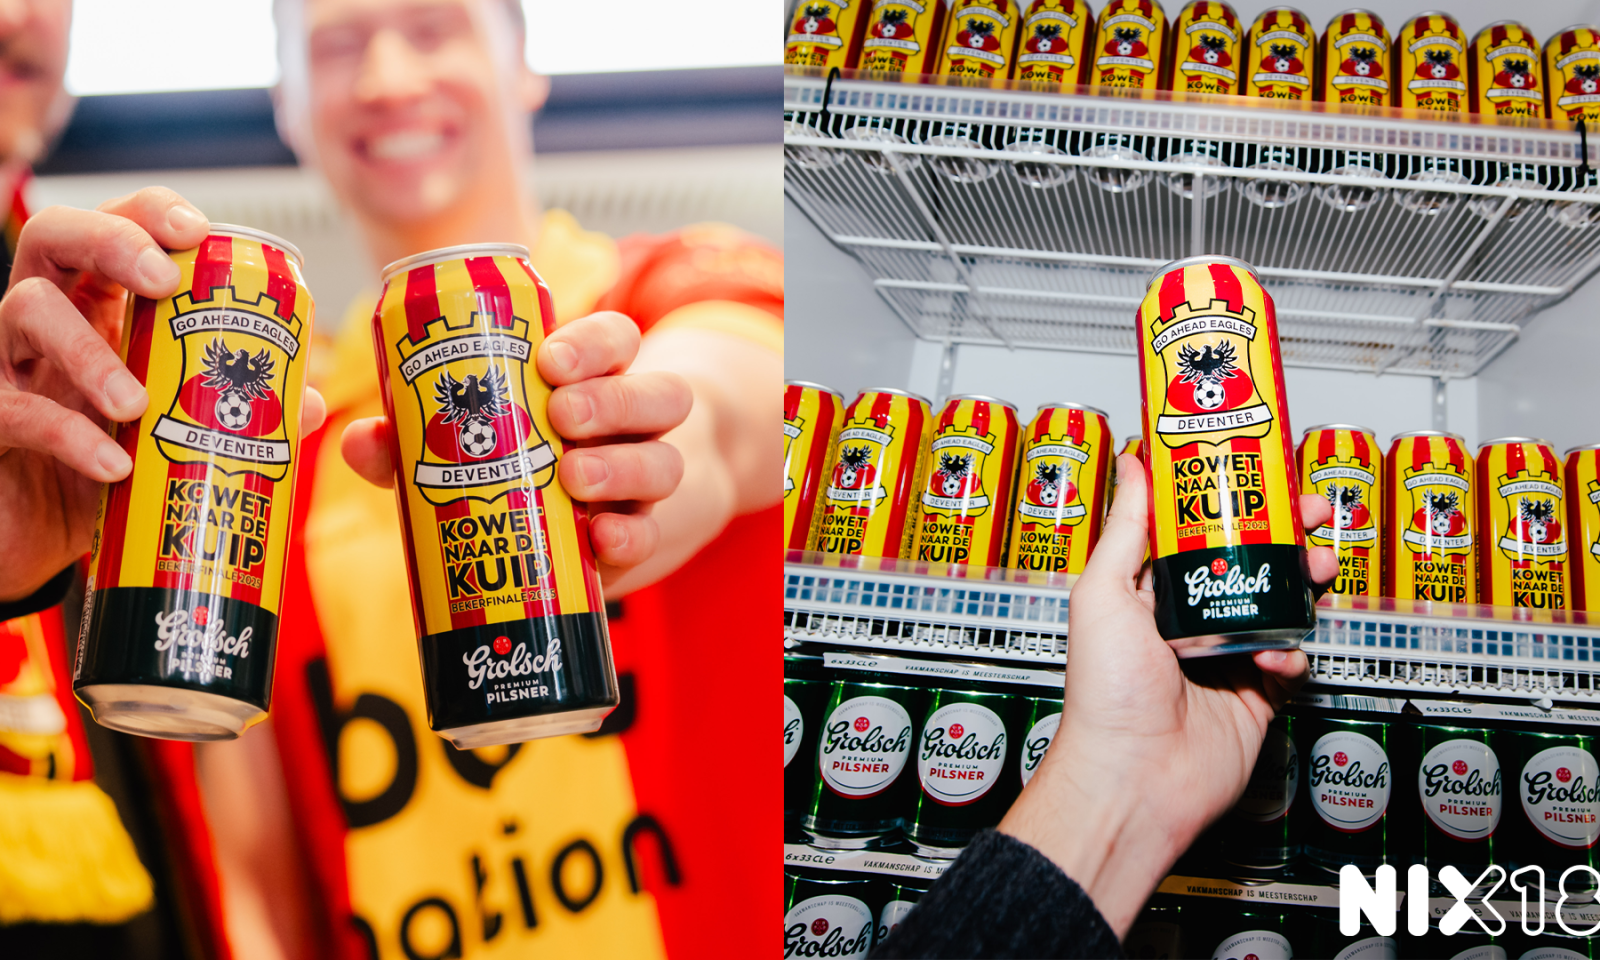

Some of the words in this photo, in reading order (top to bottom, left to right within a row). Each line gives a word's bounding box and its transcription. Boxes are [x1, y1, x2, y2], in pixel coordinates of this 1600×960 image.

[949, 64, 994, 78] KOWET
[1021, 70, 1063, 82] KOWET
[1100, 74, 1144, 85] KOWET
[1187, 81, 1229, 95] KOWET
[1417, 97, 1460, 109] KOWET
[176, 317, 197, 332] GO
[201, 315, 250, 328] AHEAD
[253, 320, 295, 353] EAGLES
[1155, 335, 1168, 349] GO
[1170, 320, 1207, 338] AHEAD
[1210, 319, 1252, 336] EAGLES
[405, 359, 422, 377] GO
[424, 342, 469, 365] AHEAD
[473, 340, 526, 356] EAGLES
[1177, 411, 1254, 430] DEVENTER
[186, 429, 275, 459] DEVENTER
[940, 438, 962, 446] AHEAD
[962, 439, 990, 452] EAGLES
[1036, 447, 1058, 455] AHEAD
[1058, 448, 1086, 460] EAGLES
[442, 456, 534, 483] DEVENTER
[1173, 453, 1261, 480] KOWET
[1312, 472, 1322, 481] GO
[1323, 469, 1347, 478] AHEAD
[1348, 469, 1373, 482] EAGLES
[1175, 474, 1230, 496] NAAR
[1236, 472, 1263, 488] DE
[1407, 478, 1418, 487] GO
[1444, 477, 1469, 490] EAGLES
[1501, 486, 1513, 495] GO
[1514, 483, 1540, 491] AHEAD
[168, 479, 270, 519] KOWET
[930, 499, 975, 508] DEVENTR
[1177, 489, 1265, 526] KUIP
[166, 503, 234, 530] NAAR
[239, 516, 267, 539] DE
[440, 506, 544, 544] KOWET
[822, 514, 867, 527] KOWET
[819, 526, 845, 537] NAAR
[846, 528, 864, 538] DE
[922, 522, 972, 537] KOWET
[1177, 521, 1244, 539] BEKERFINLE
[1246, 520, 1269, 531] 2025
[1321, 529, 1369, 539] DEENTER
[816, 536, 862, 555] KUIP
[920, 534, 949, 546] NAAR
[953, 536, 970, 547] DE
[1020, 531, 1071, 546] KOWET
[1419, 535, 1465, 546] DVENTER
[161, 523, 265, 570] KUIP
[444, 535, 510, 564] NAAR
[516, 530, 547, 553] DE
[1019, 543, 1048, 555] NAAR
[1051, 545, 1068, 556] DE
[1524, 544, 1562, 554] EVENTER
[919, 546, 969, 564] KUIP
[1338, 556, 1368, 569] WET
[1017, 554, 1068, 573] KUIP
[1414, 561, 1466, 576] KOWET
[158, 559, 239, 581] BEKERFINALE
[239, 572, 262, 589] 2025
[446, 552, 551, 599] KUIP
[1352, 568, 1367, 579] DE
[1415, 573, 1449, 584] NAAR
[1452, 575, 1465, 586] DE
[1512, 569, 1563, 582] KOWET
[1184, 562, 1271, 607] Grolsch
[1328, 579, 1368, 596] UIP
[1512, 581, 1548, 592] NAAR
[1550, 583, 1563, 593] DE
[451, 591, 528, 613] BEKERFINALE
[530, 588, 557, 601] 2025
[1414, 583, 1466, 604] KUIP
[1513, 591, 1564, 610] KUIP
[1209, 597, 1251, 607] PREMIUM
[1202, 603, 1259, 620] PILSNER
[154, 609, 253, 659] Grolsch
[172, 658, 233, 680] PILSNER
[462, 637, 563, 690] Grolsch
[904, 664, 959, 676] VAKMANSCHAP
[961, 669, 971, 677] IS
[972, 670, 1032, 681] MEESTERSCHAP
[494, 679, 540, 690] PREMIUM
[487, 685, 550, 704] PILSNER
[1498, 709, 1553, 720] VAKMANSCHAP
[823, 720, 911, 755] Grolsch
[921, 726, 1006, 762] Grolsch
[841, 755, 884, 763] PREMIUM
[938, 762, 979, 770] PREMIUM
[832, 761, 889, 774] PILSNER
[929, 767, 985, 781] PILSNER
[1309, 754, 1389, 789] Grolsch
[1422, 763, 1500, 798] Grolsch
[1328, 788, 1367, 798] PREMIUM
[1321, 794, 1374, 809] PILSNER
[1447, 798, 1487, 806] PREMIUM
[1439, 803, 1493, 817] PILSNER
[1544, 811, 1596, 824] PILSNER
[863, 860, 922, 873] VAKMANSCHAP
[924, 864, 933, 874] IS
[1186, 885, 1244, 897] VAKMANSCHAP
[1246, 889, 1255, 898] IS
[1258, 890, 1318, 902] MEESTERSCHAP
[784, 920, 873, 958] Grolsch
